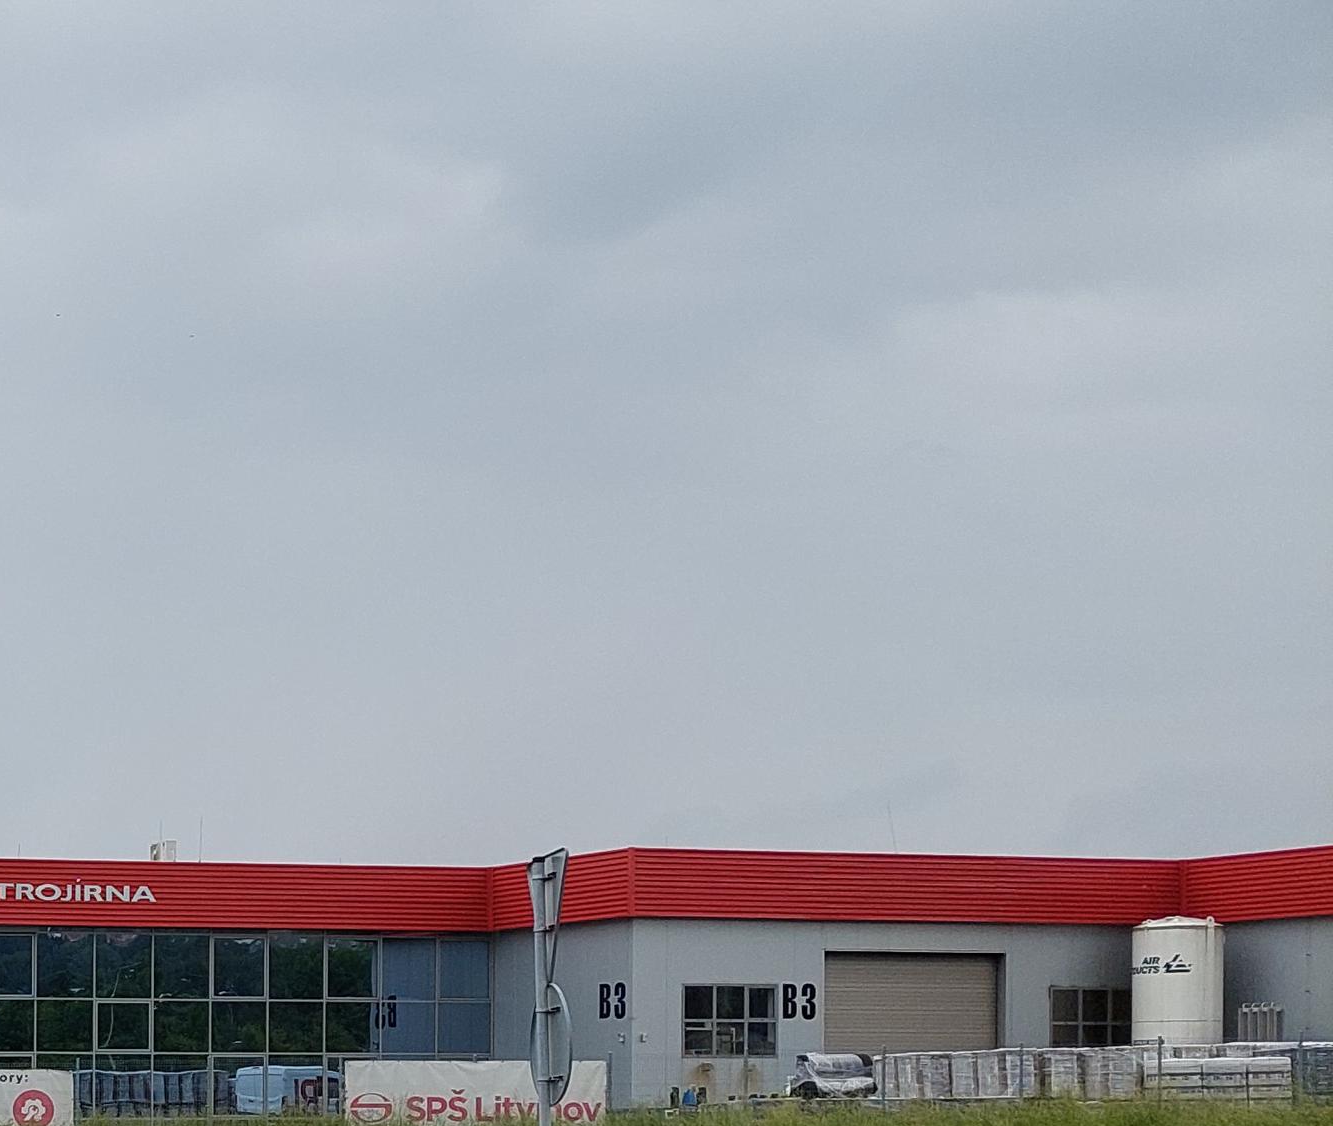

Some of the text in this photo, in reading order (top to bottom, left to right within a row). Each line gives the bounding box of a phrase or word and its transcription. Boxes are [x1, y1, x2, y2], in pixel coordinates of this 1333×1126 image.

[1142, 957, 1160, 965] AIR
[599, 982, 626, 1019] B3
[782, 983, 817, 1020] B3
[405, 1088, 468, 1122] SPŠ
